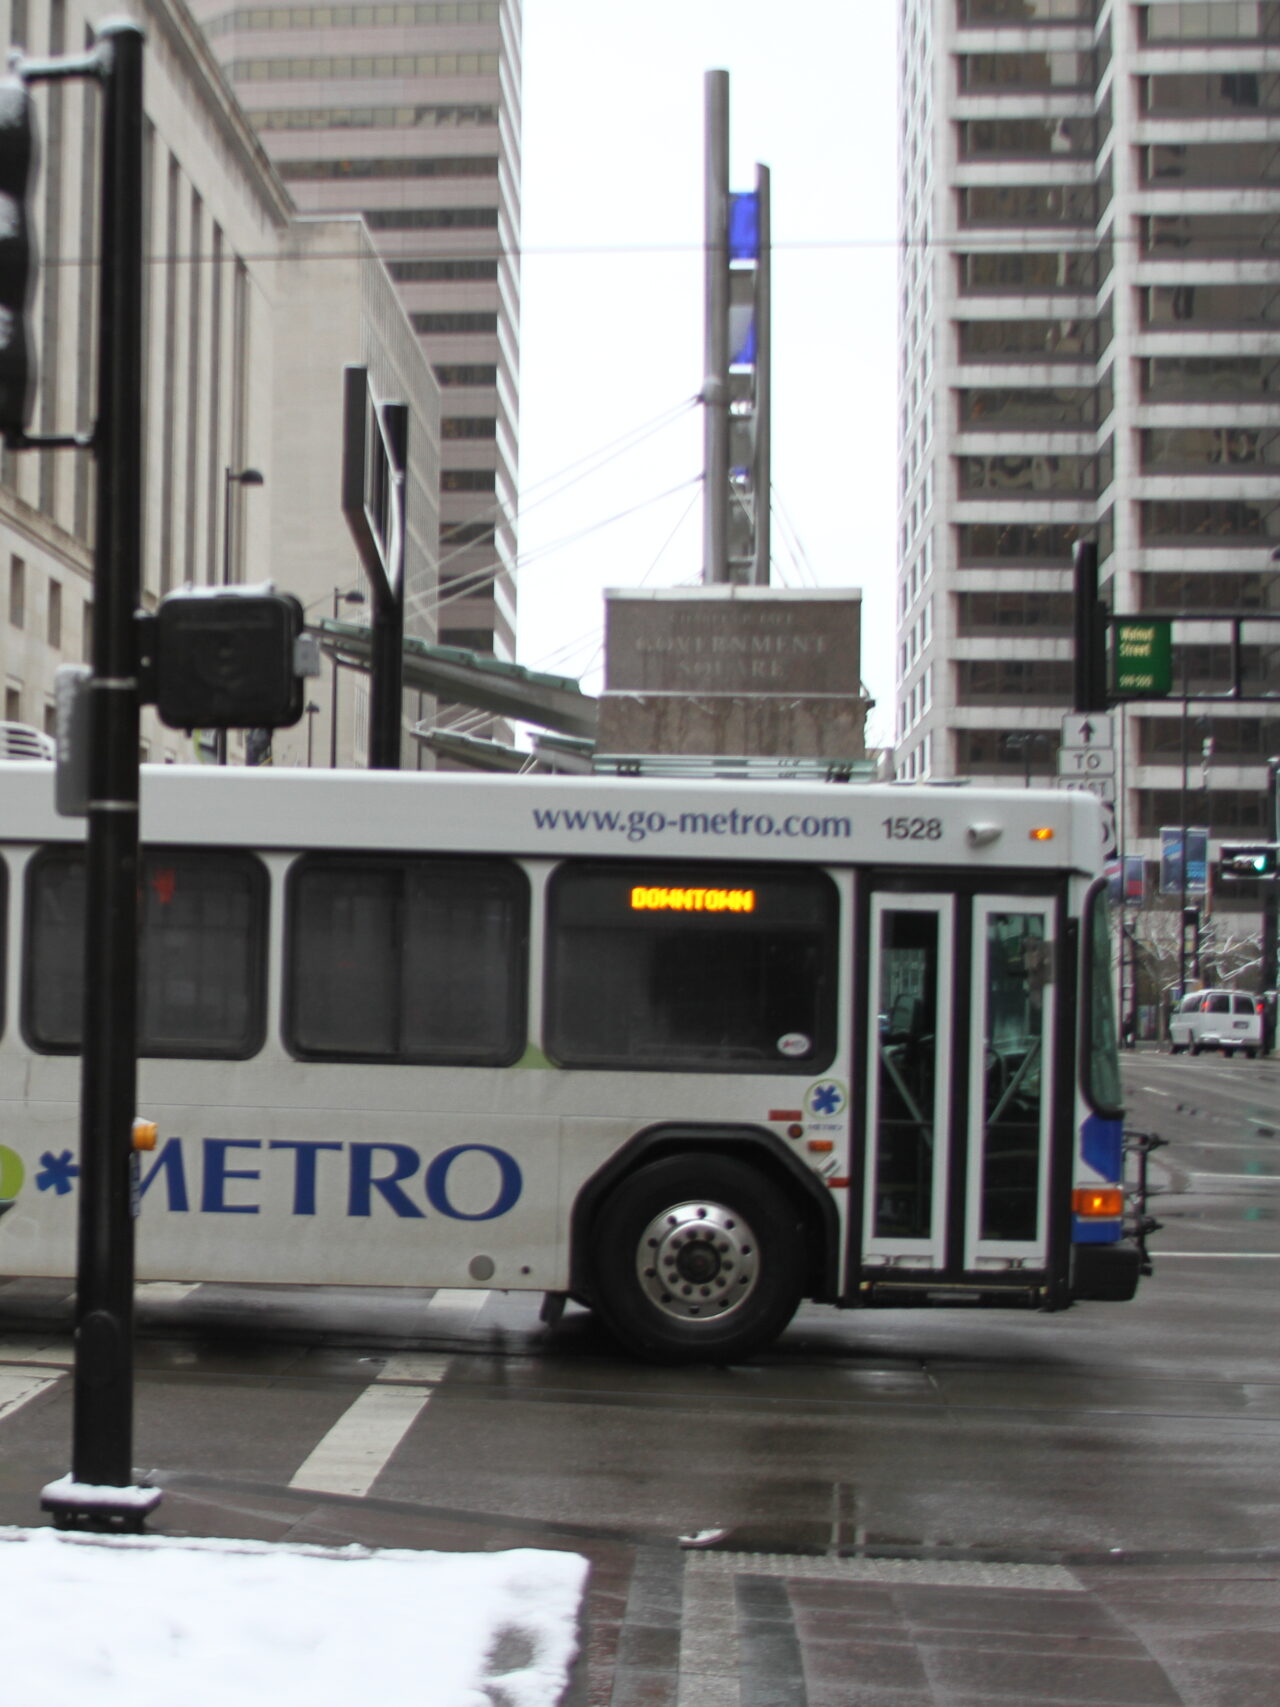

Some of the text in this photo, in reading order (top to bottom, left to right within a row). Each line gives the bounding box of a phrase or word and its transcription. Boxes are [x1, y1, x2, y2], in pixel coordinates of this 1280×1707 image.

[635, 634, 827, 654] GOVERNMENT
[1120, 642, 1151, 657] Street
[679, 659, 785, 677] SQUARE
[1073, 754, 1101, 769] TO
[532, 808, 852, 842] www.go-metro.com
[881, 817, 942, 840] 1528
[630, 886, 754, 912] DOWNTOWN
